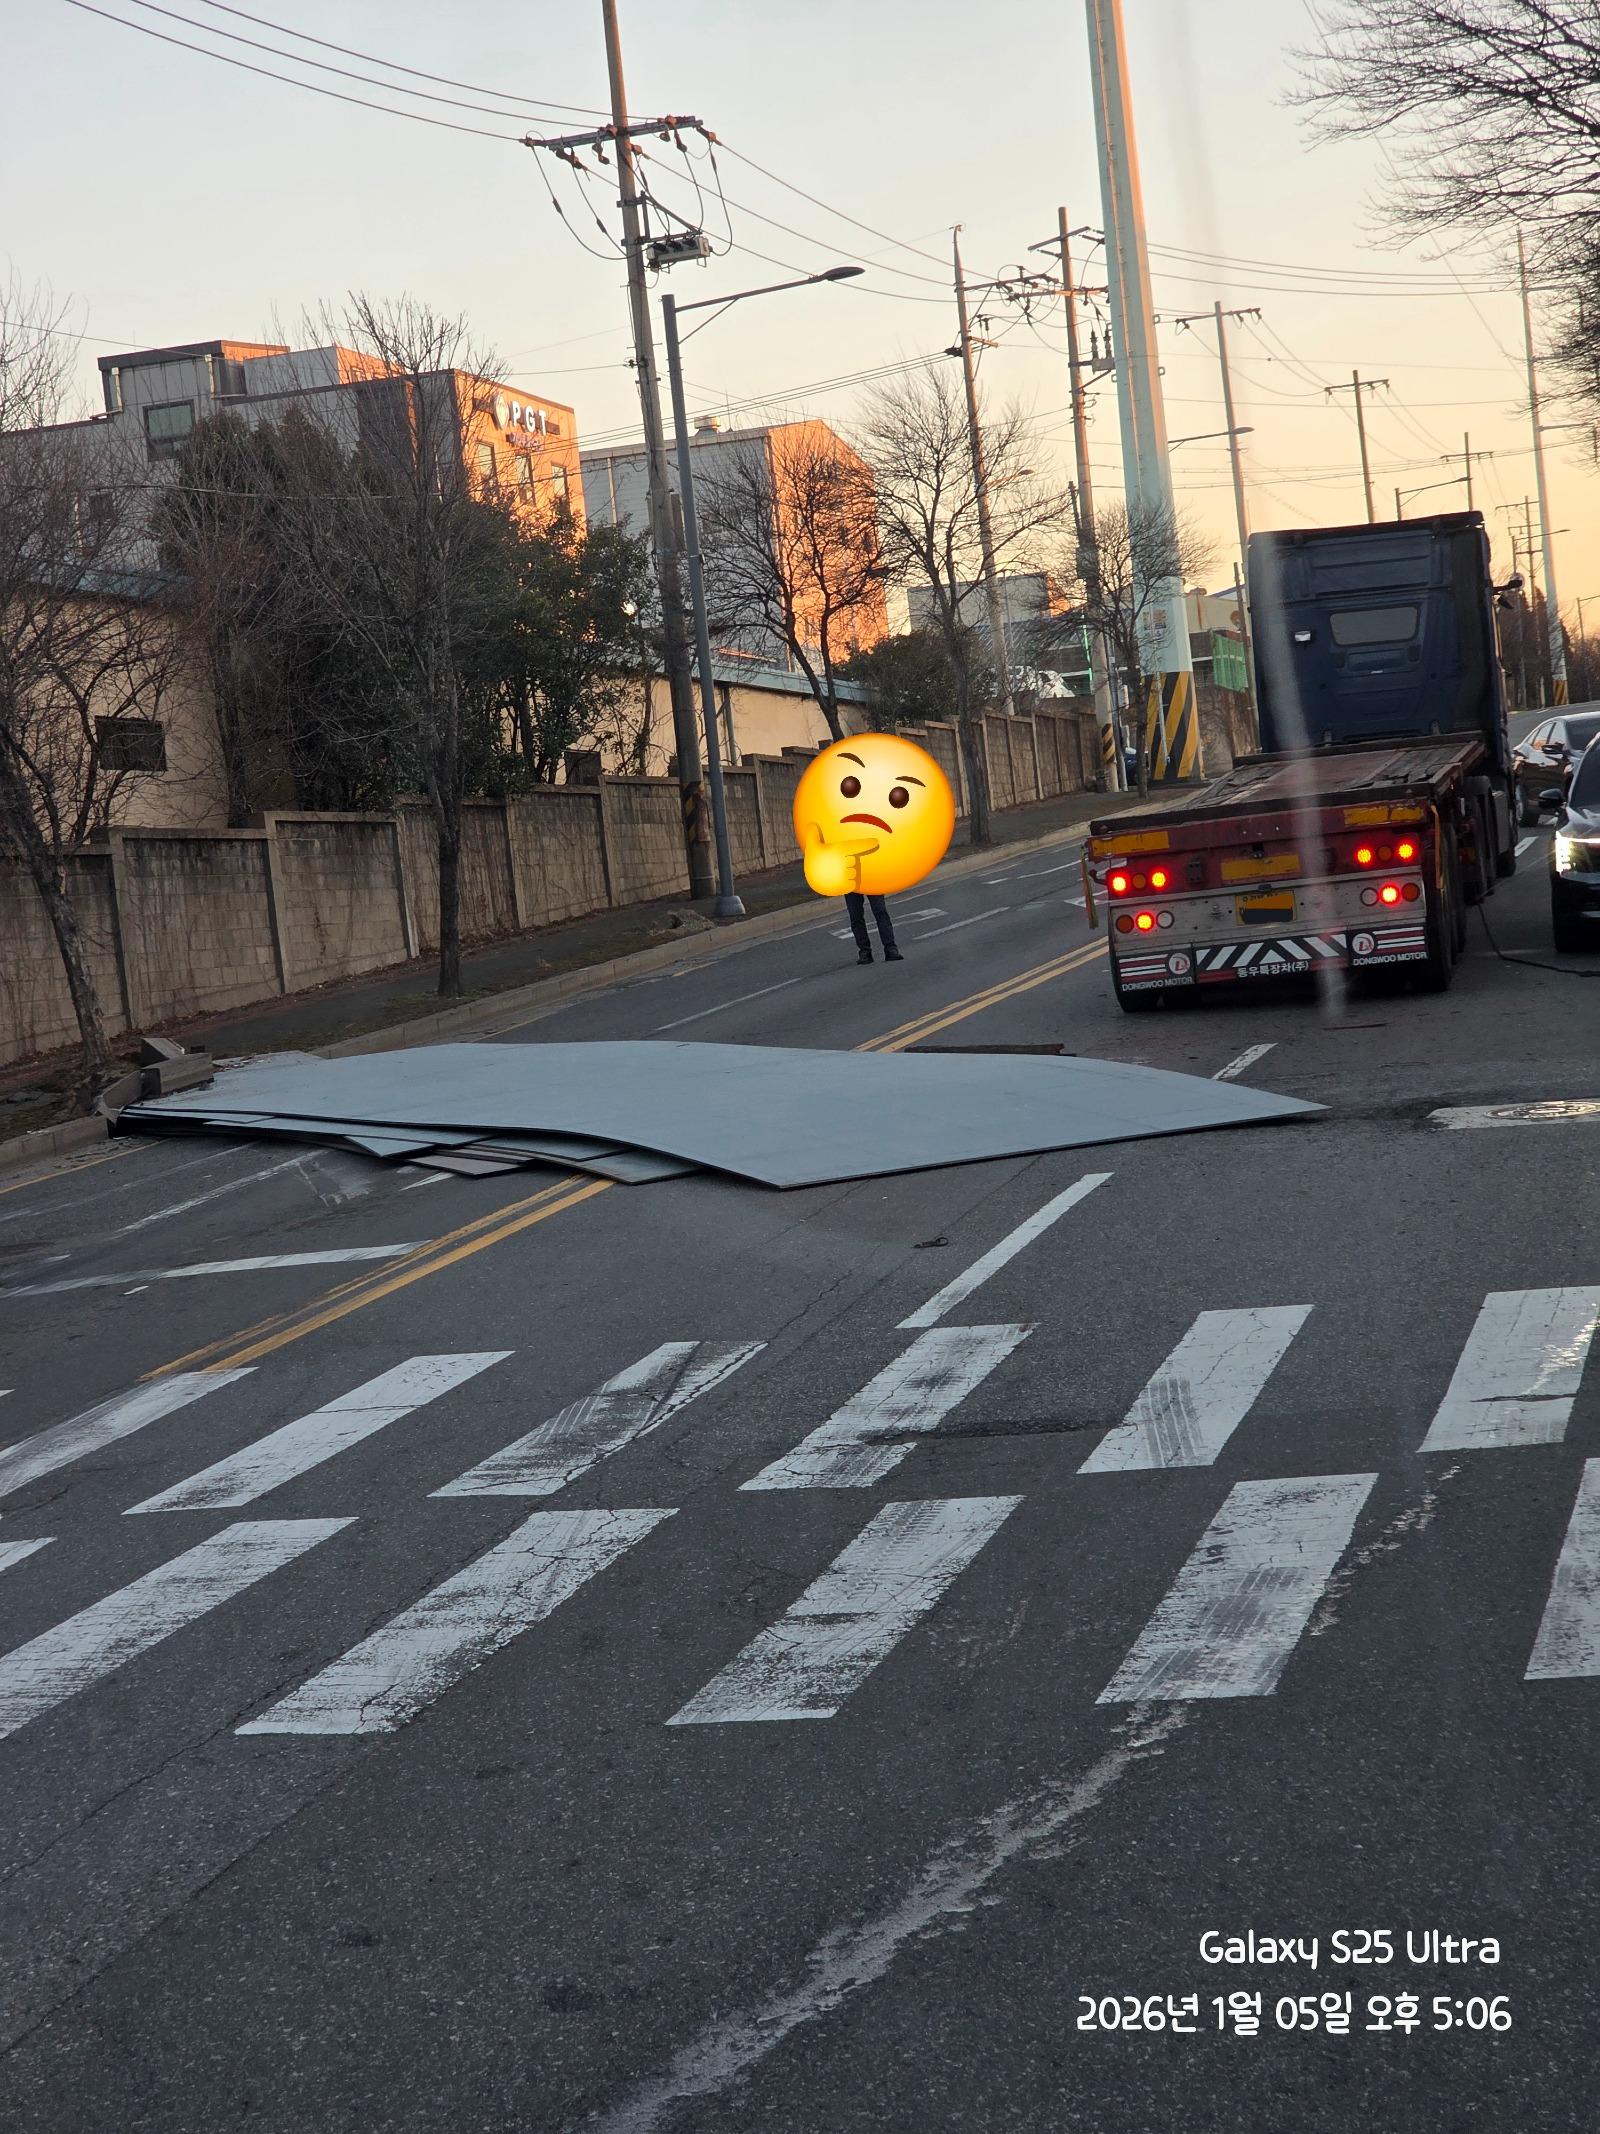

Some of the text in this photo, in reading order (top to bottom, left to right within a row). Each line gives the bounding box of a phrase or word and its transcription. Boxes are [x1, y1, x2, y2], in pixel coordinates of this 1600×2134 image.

[511, 400, 547, 437] PGT
[1352, 951, 1428, 966] DONGWOO MOTOR
[1237, 960, 1309, 978] 동우특장차(주)
[1122, 976, 1193, 991] DONGWOO MOTOR
